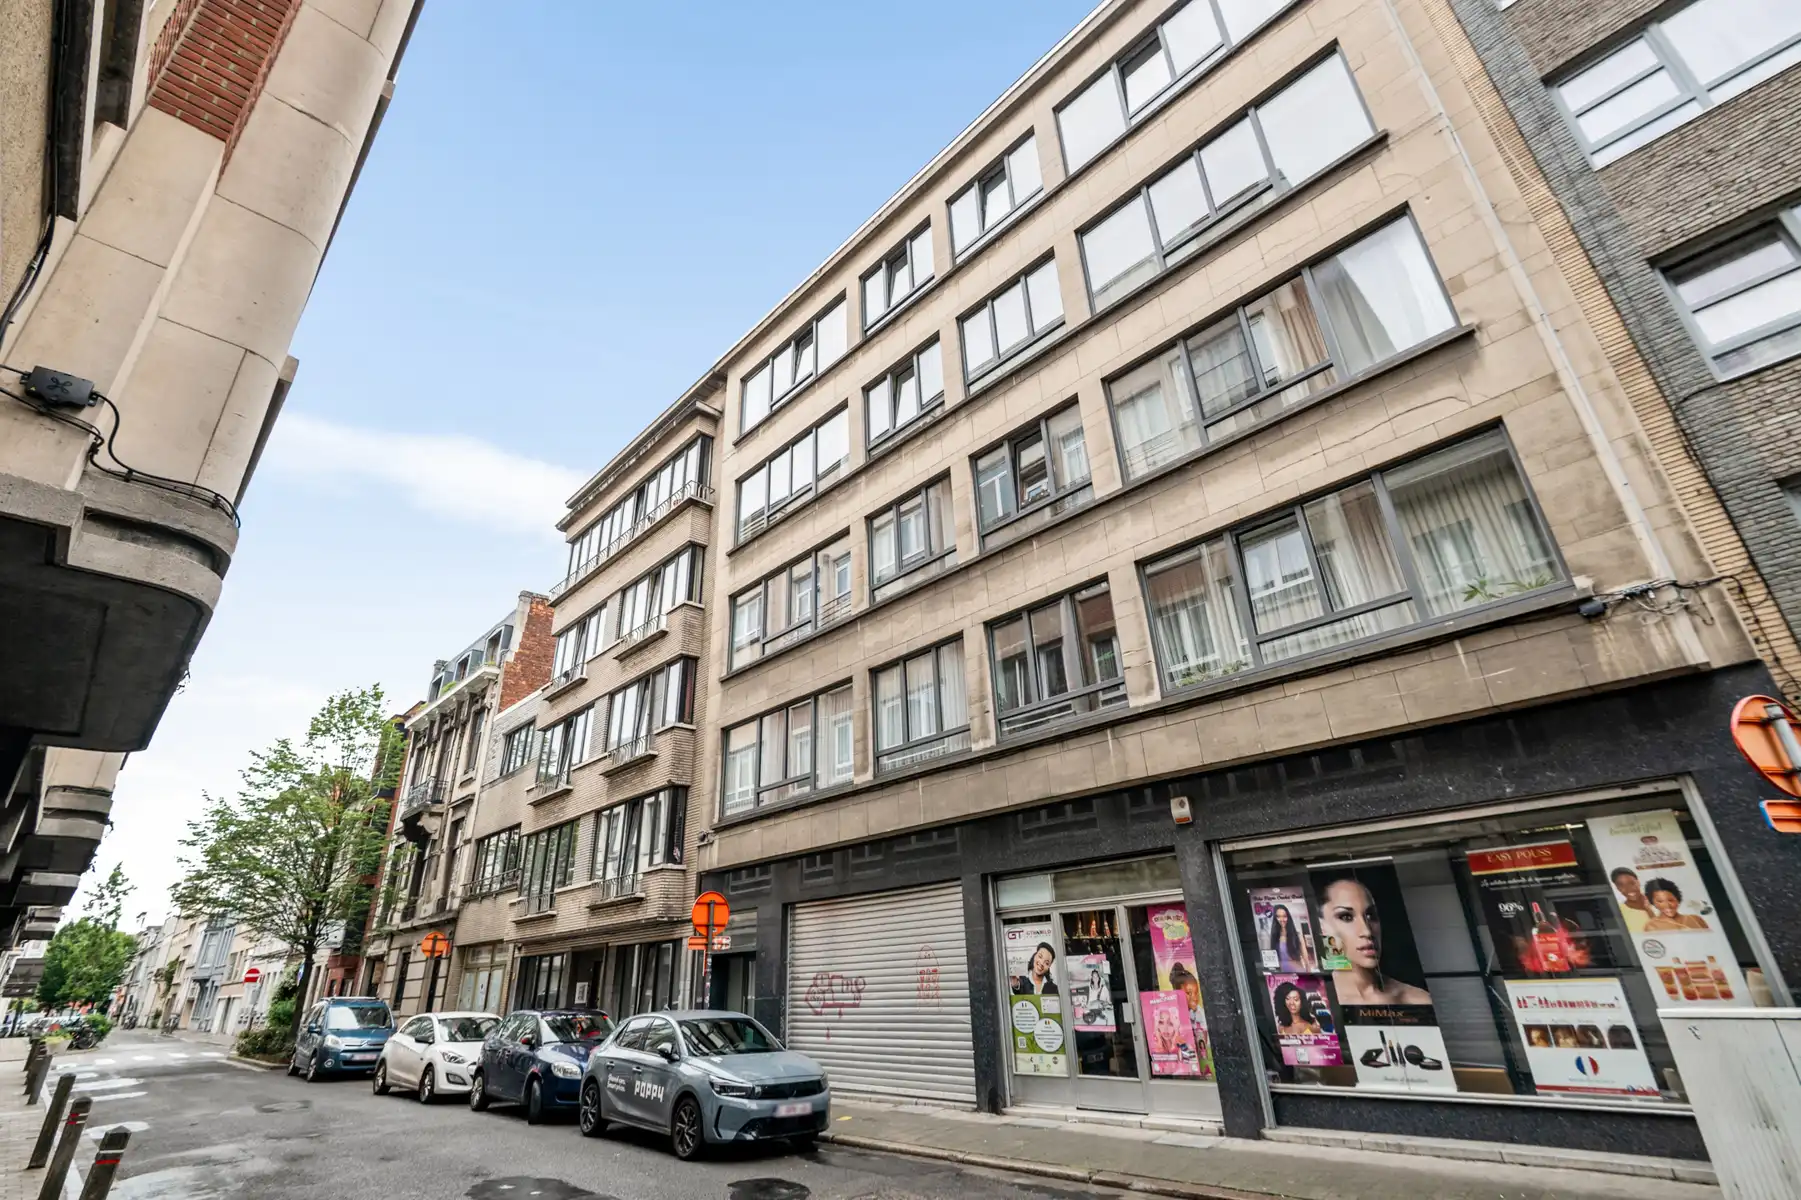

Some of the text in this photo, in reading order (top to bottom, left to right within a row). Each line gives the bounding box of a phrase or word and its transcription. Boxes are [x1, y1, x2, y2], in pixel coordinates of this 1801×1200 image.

[1486, 848, 1552, 863] EASY POUSS
[1008, 930, 1024, 940] GT
[634, 1080, 664, 1102] POPPY
